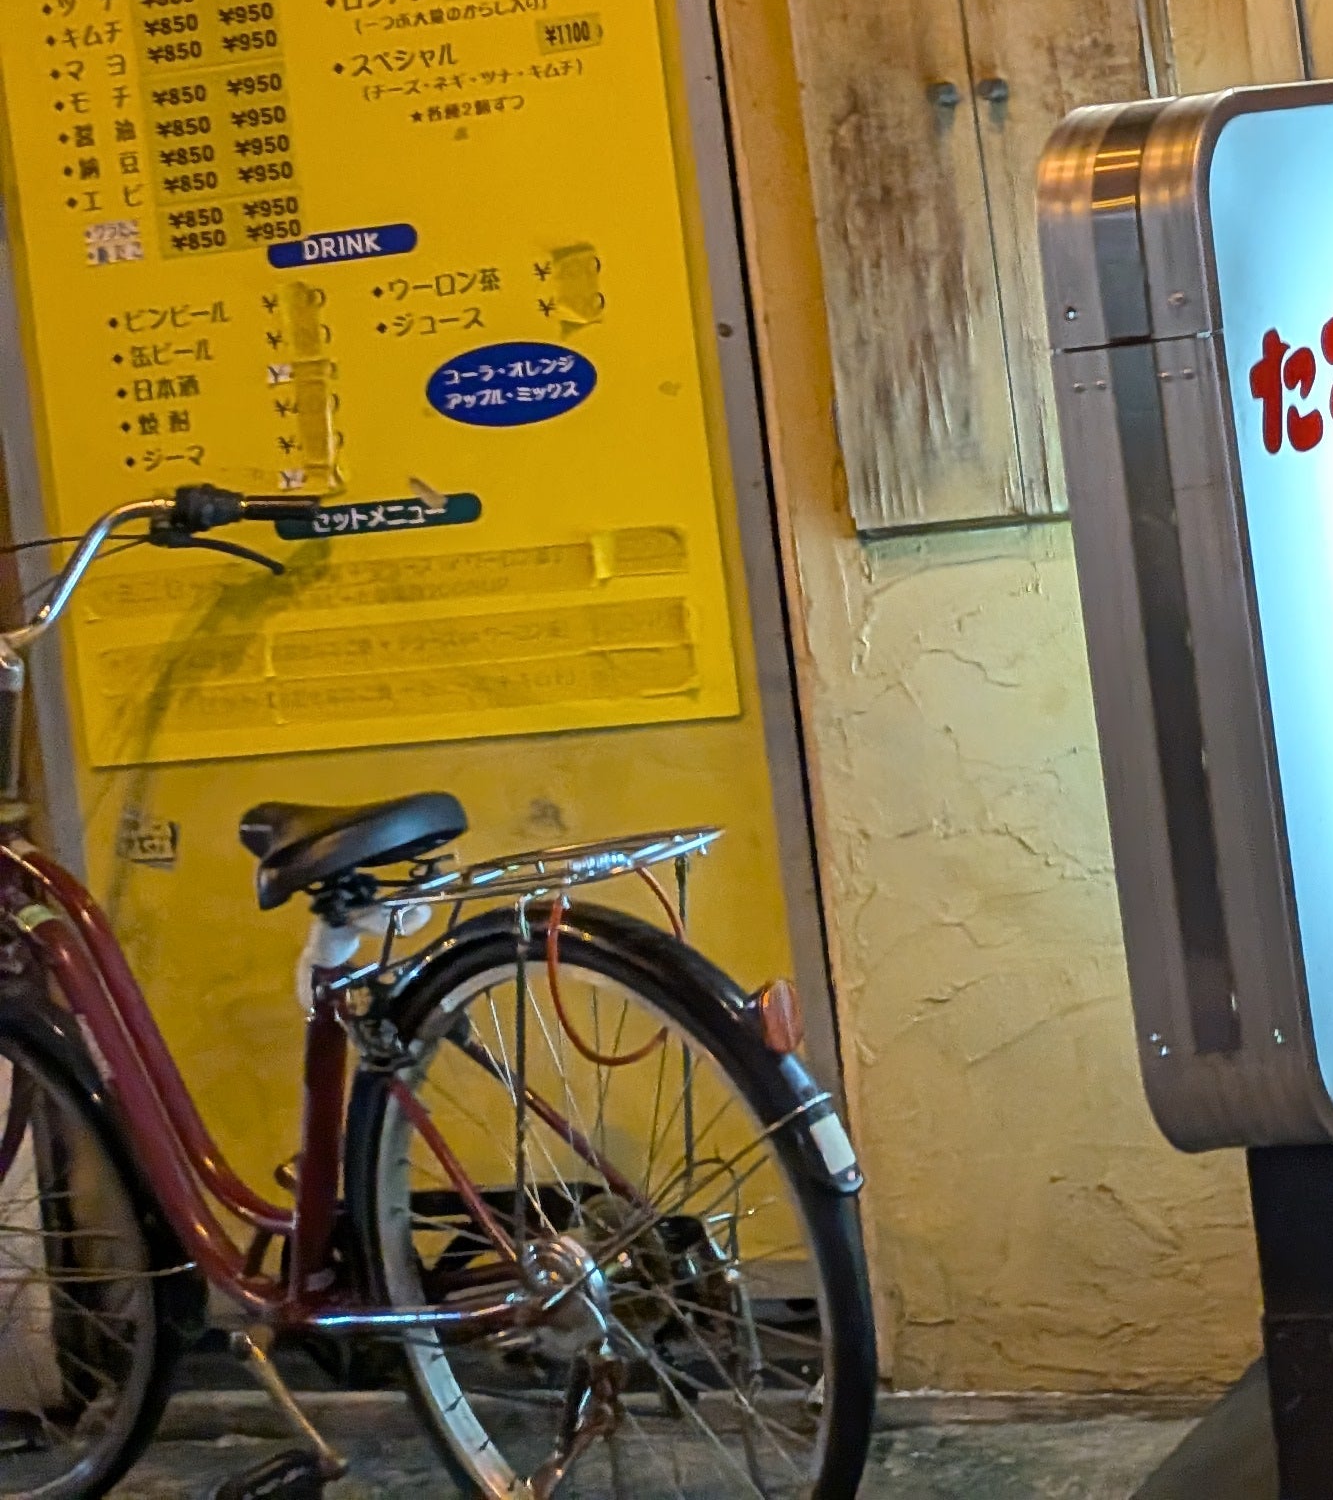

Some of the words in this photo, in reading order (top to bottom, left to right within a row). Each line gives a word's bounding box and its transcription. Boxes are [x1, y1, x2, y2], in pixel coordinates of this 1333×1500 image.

[61, 20, 124, 50] キムチ
[144, 14, 199, 39] ¥850
[218, 2, 274, 27] ¥950
[65, 53, 127, 82] マヨ
[147, 40, 203, 64] ¥850
[221, 29, 278, 54] ¥950
[351, 43, 459, 77] スペシャル
[545, 20, 592, 46] ¥1100
[70, 85, 131, 113] モチ
[151, 84, 207, 108] ¥850
[226, 73, 282, 97] ¥950
[155, 116, 211, 139] ¥850
[230, 105, 287, 129] ¥950
[159, 144, 215, 168] ¥850
[234, 134, 290, 157] ¥950
[82, 182, 148, 211] エビ
[163, 171, 218, 194] ¥850
[237, 161, 293, 185] ¥950
[168, 206, 224, 230] ¥850
[243, 196, 299, 220] ¥950
[171, 228, 227, 252] ¥850
[246, 218, 302, 242] ¥950
[303, 230, 381, 261] DRINK
[388, 268, 501, 301] ウーロン茶
[392, 307, 484, 336] ジュース
[131, 339, 213, 369] 缶ビール
[443, 354, 576, 386] コーラ・オレンジ
[134, 374, 200, 402] 日本酒
[444, 380, 580, 410] アップル・ミックス
